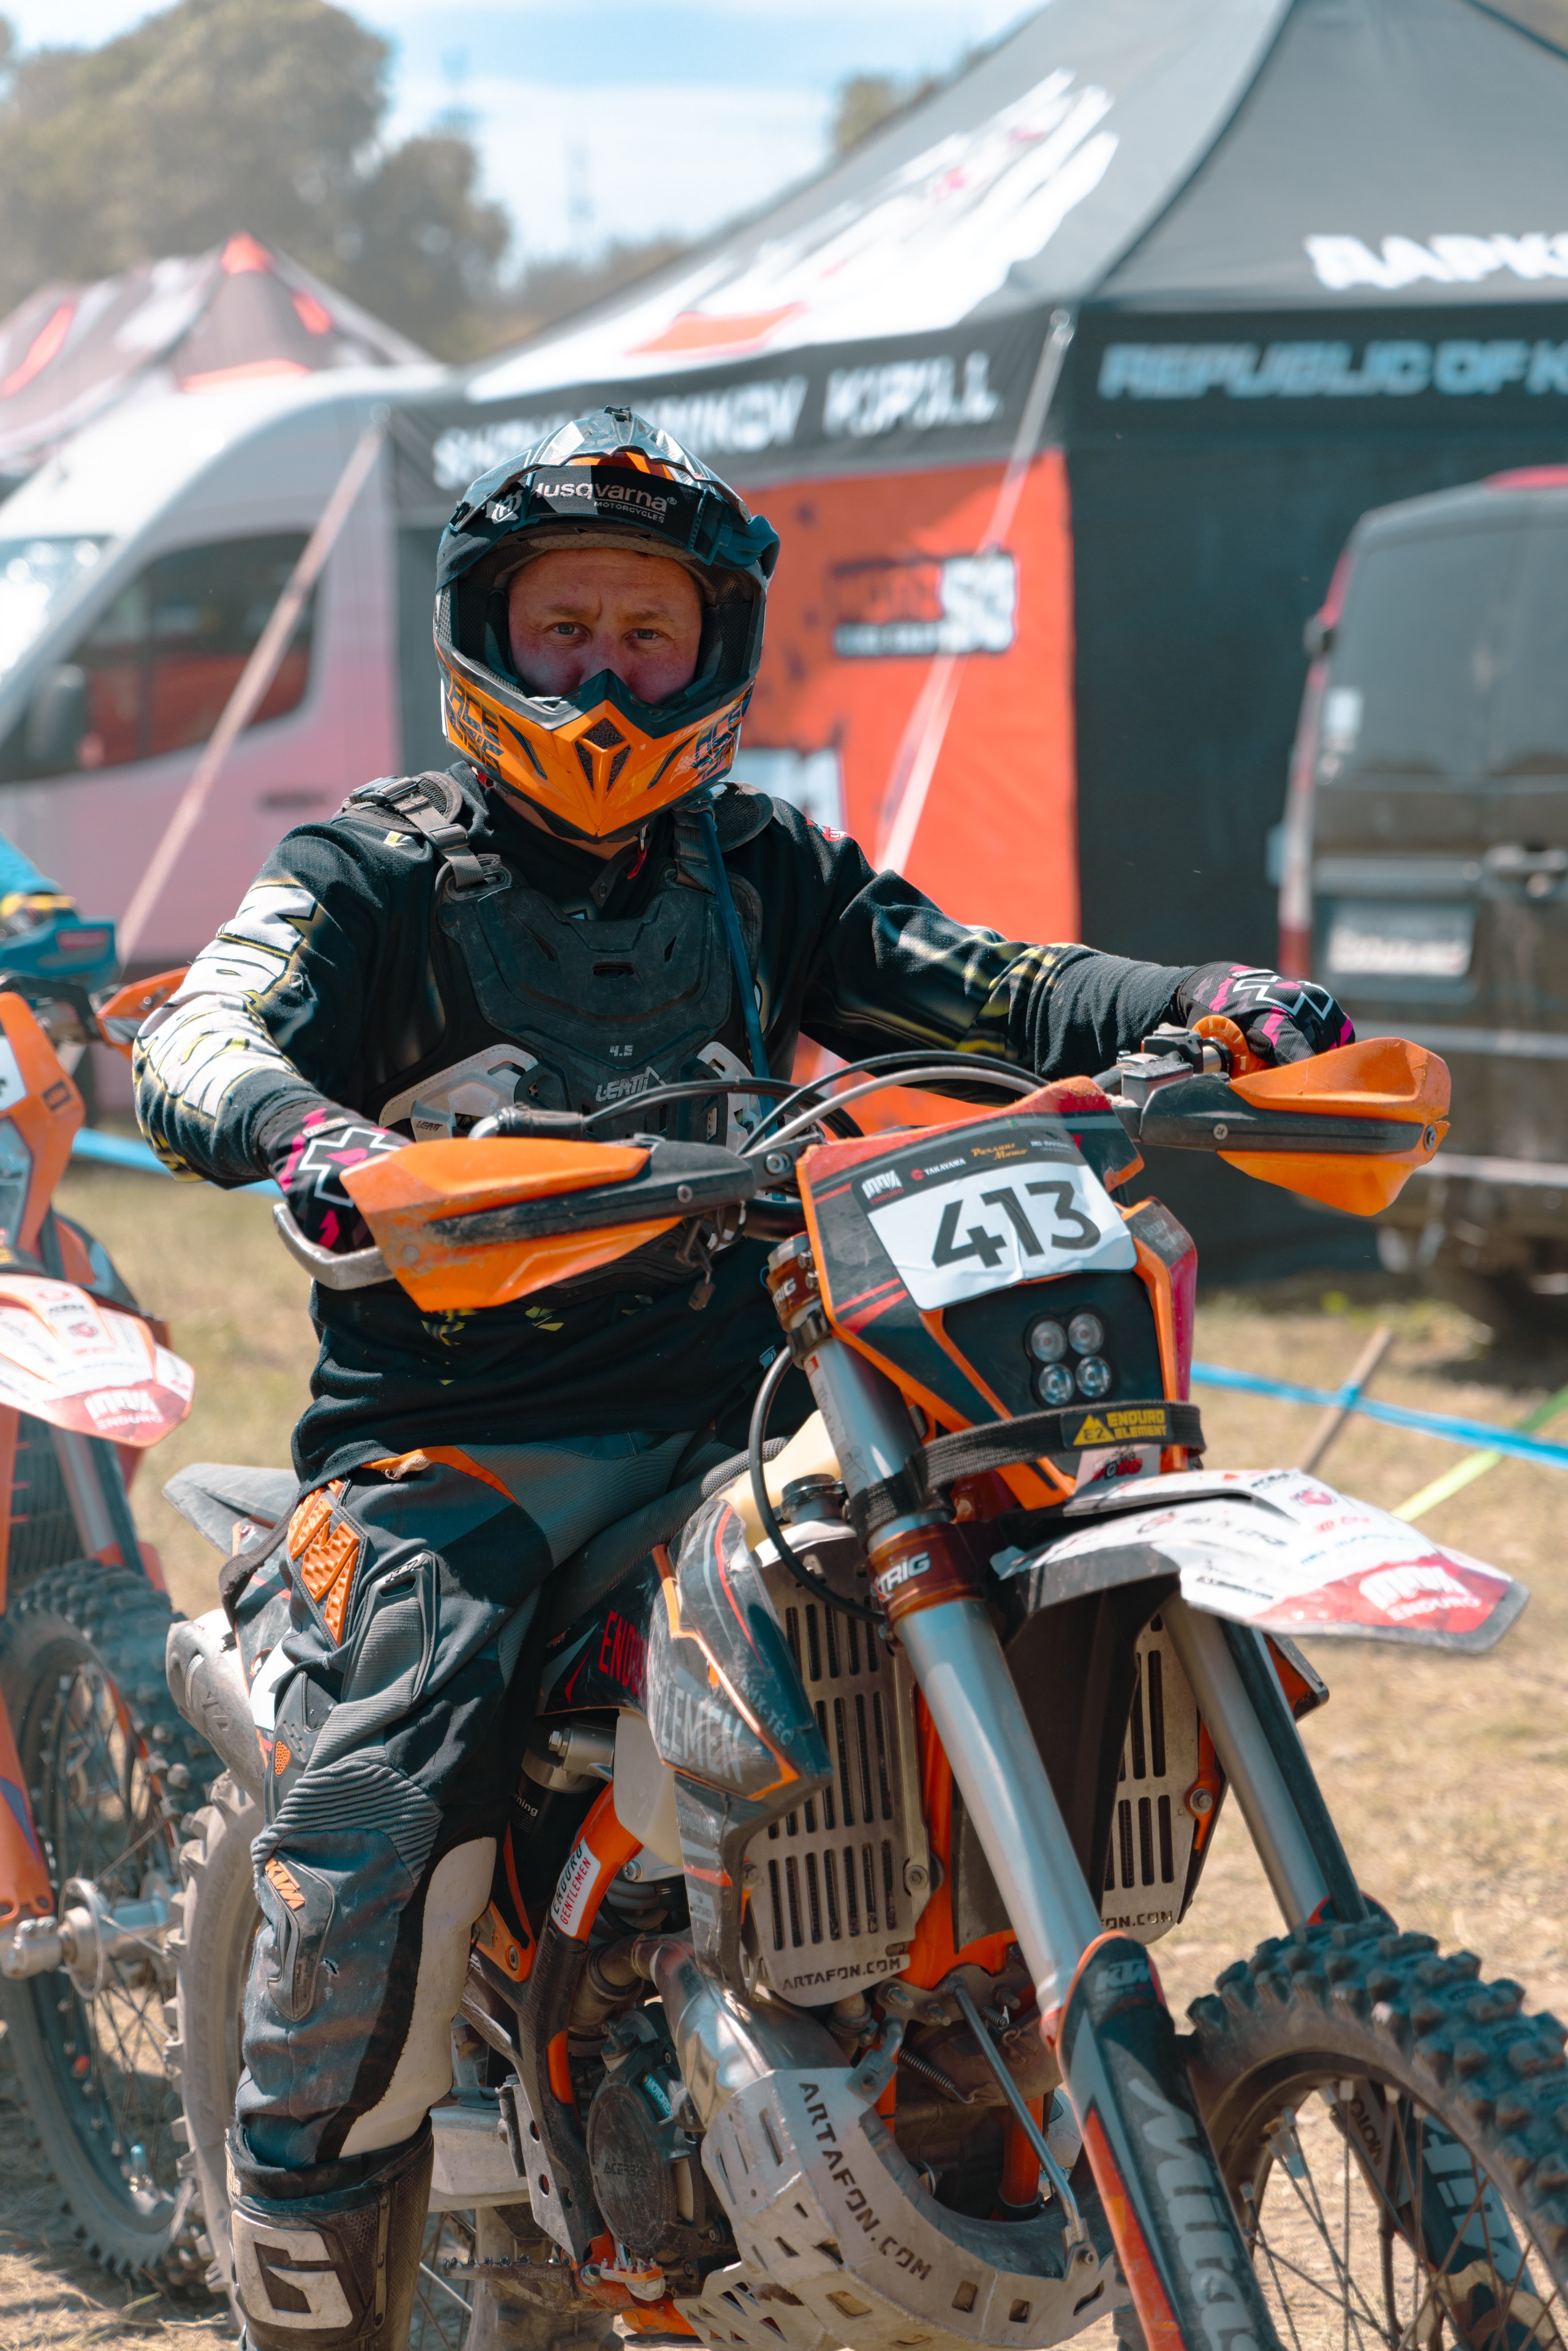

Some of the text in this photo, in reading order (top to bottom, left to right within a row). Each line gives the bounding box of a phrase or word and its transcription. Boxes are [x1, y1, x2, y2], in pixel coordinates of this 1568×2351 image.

[594, 501, 665, 524] MOTORCYCLES
[609, 1044, 633, 1057] 4.5
[415, 1120, 443, 1131] LEATT
[924, 1157, 967, 1176] TAKAYAMA
[870, 1187, 905, 1206] ENDURO
[931, 1180, 1101, 1269] 413
[95, 1411, 163, 1430] ENDURO
[1106, 1409, 1166, 1428] ENDURO
[1114, 1425, 1167, 1440] ELEMENT
[1386, 1596, 1481, 1621] ENDURO
[554, 1843, 582, 1915] ENDURO
[560, 1856, 592, 1926] GENTLEMEN
[783, 1957, 901, 1991] ARTAFON.COM
[1094, 1958, 1152, 1993] KTM
[799, 2082, 933, 2281] ARTAFON.COM
